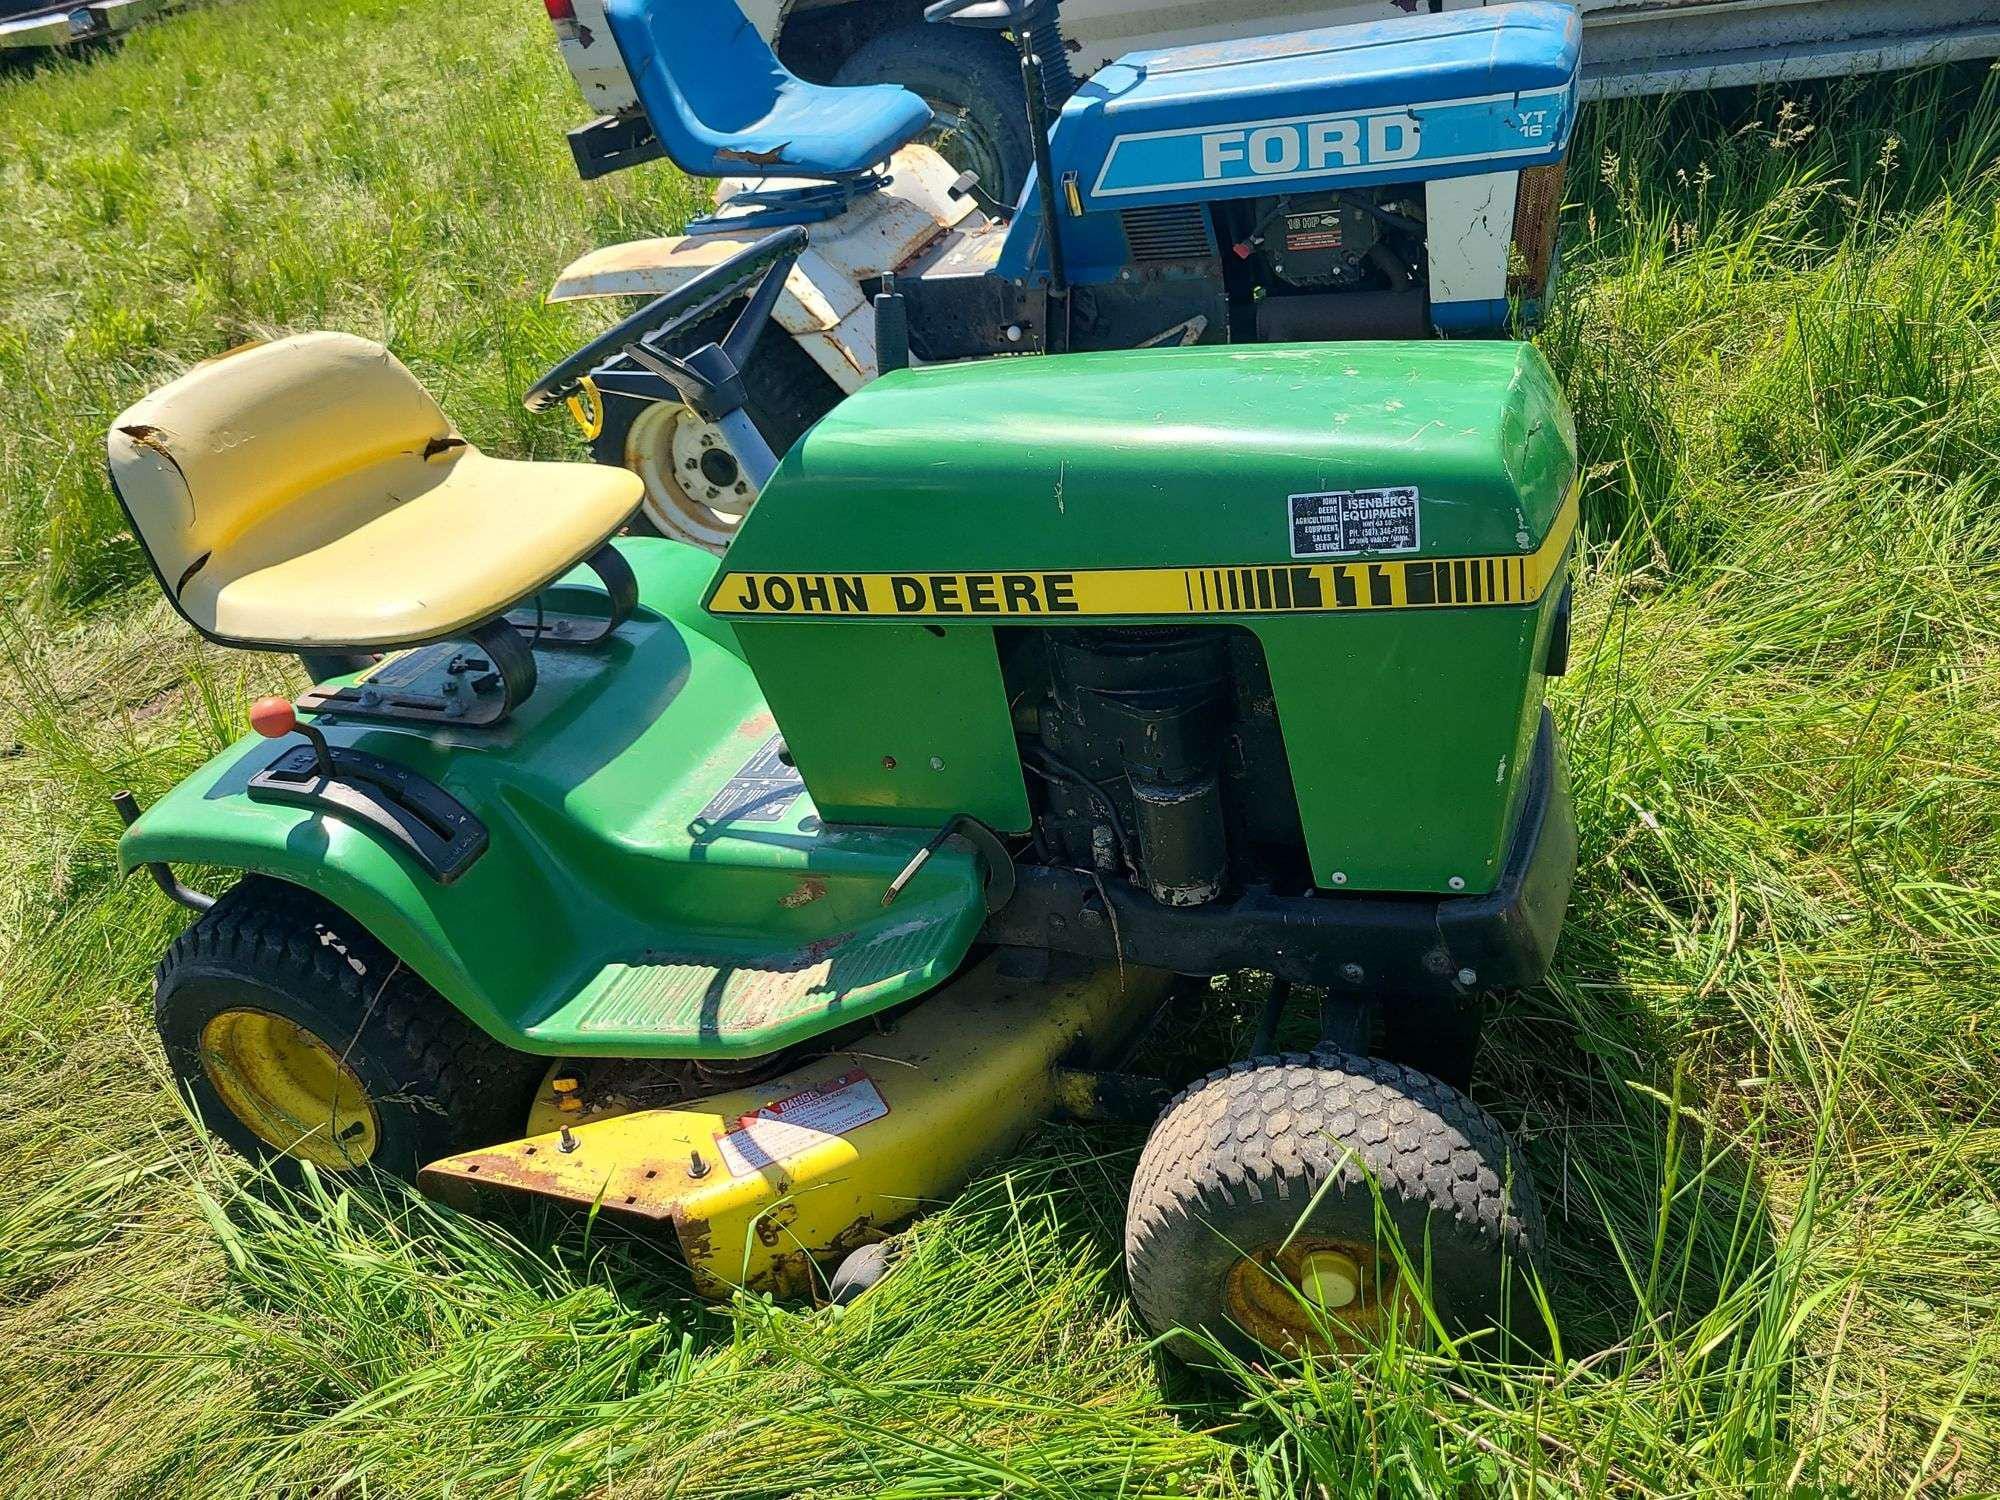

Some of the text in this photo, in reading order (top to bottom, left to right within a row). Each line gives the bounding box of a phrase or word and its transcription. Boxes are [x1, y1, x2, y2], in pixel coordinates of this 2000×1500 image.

[1518, 110, 1547, 125] YT
[1519, 124, 1543, 138] 16
[1202, 114, 1420, 179] FORD
[1287, 216, 1320, 230] 16 HP
[1318, 506, 1338, 514] DEERE
[1348, 496, 1408, 510] ISENBERG
[1295, 515, 1338, 525] AGRICULTURAL
[1343, 506, 1414, 522] EQUIPMENT
[1304, 524, 1339, 534] EQUIPMENT
[1312, 533, 1331, 542] SALES
[1314, 542, 1340, 551] SERVICE
[1308, 562, 1407, 609] 111
[738, 574, 1080, 613] JOHN DEERE
